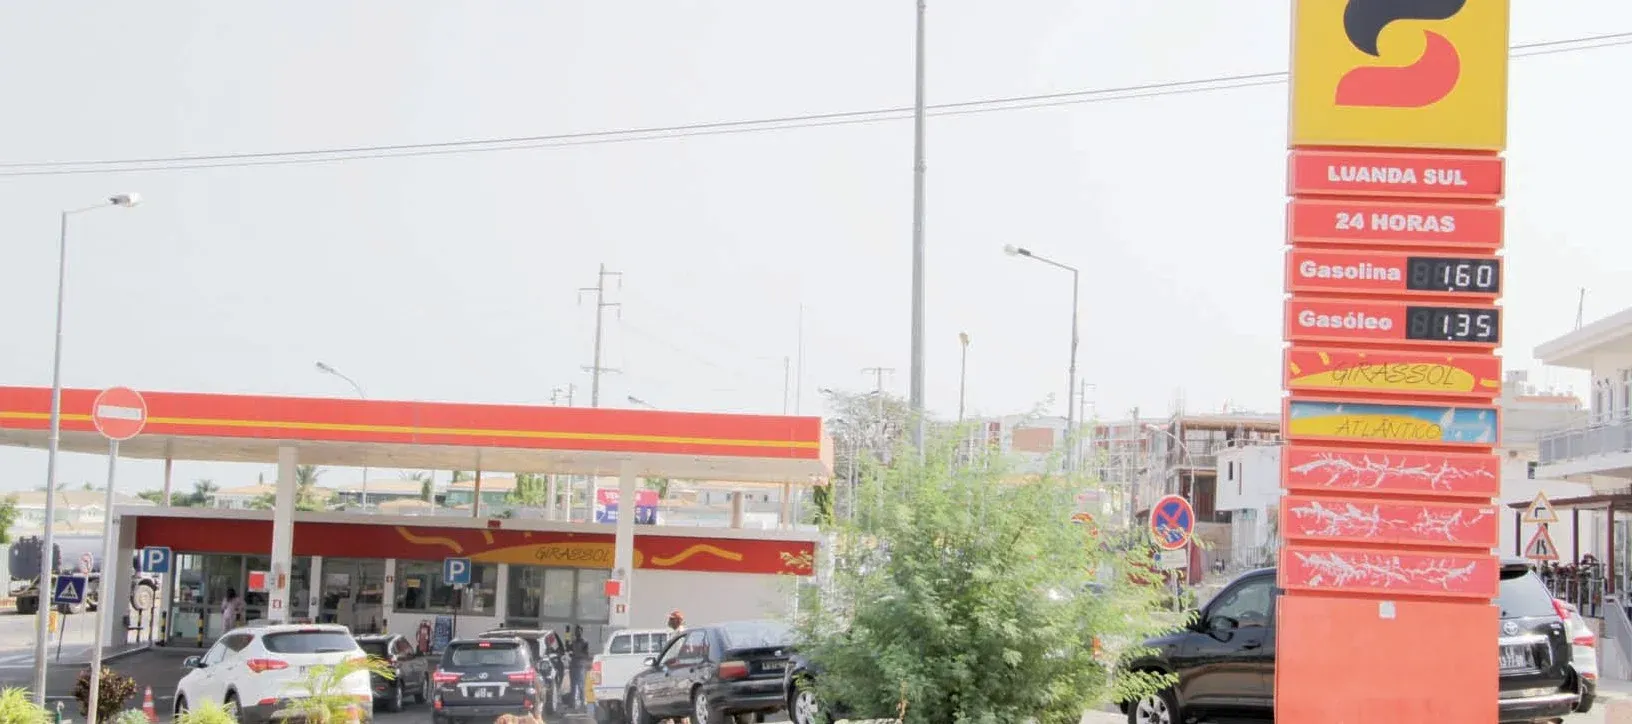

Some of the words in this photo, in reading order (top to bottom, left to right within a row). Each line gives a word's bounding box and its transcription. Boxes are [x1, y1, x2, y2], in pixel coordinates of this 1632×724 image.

[1327, 165, 1417, 184] LUANDA
[1423, 168, 1468, 186] SUL
[1335, 212, 1364, 231] 24
[1371, 213, 1456, 233] HORAS
[1300, 260, 1401, 281] Gasolina
[1298, 309, 1393, 331] Gasóleo
[1331, 361, 1455, 386] GIRASSOL
[1335, 415, 1441, 440] ATLÂNTICO
[148, 549, 164, 571] P
[450, 560, 465, 581] P
